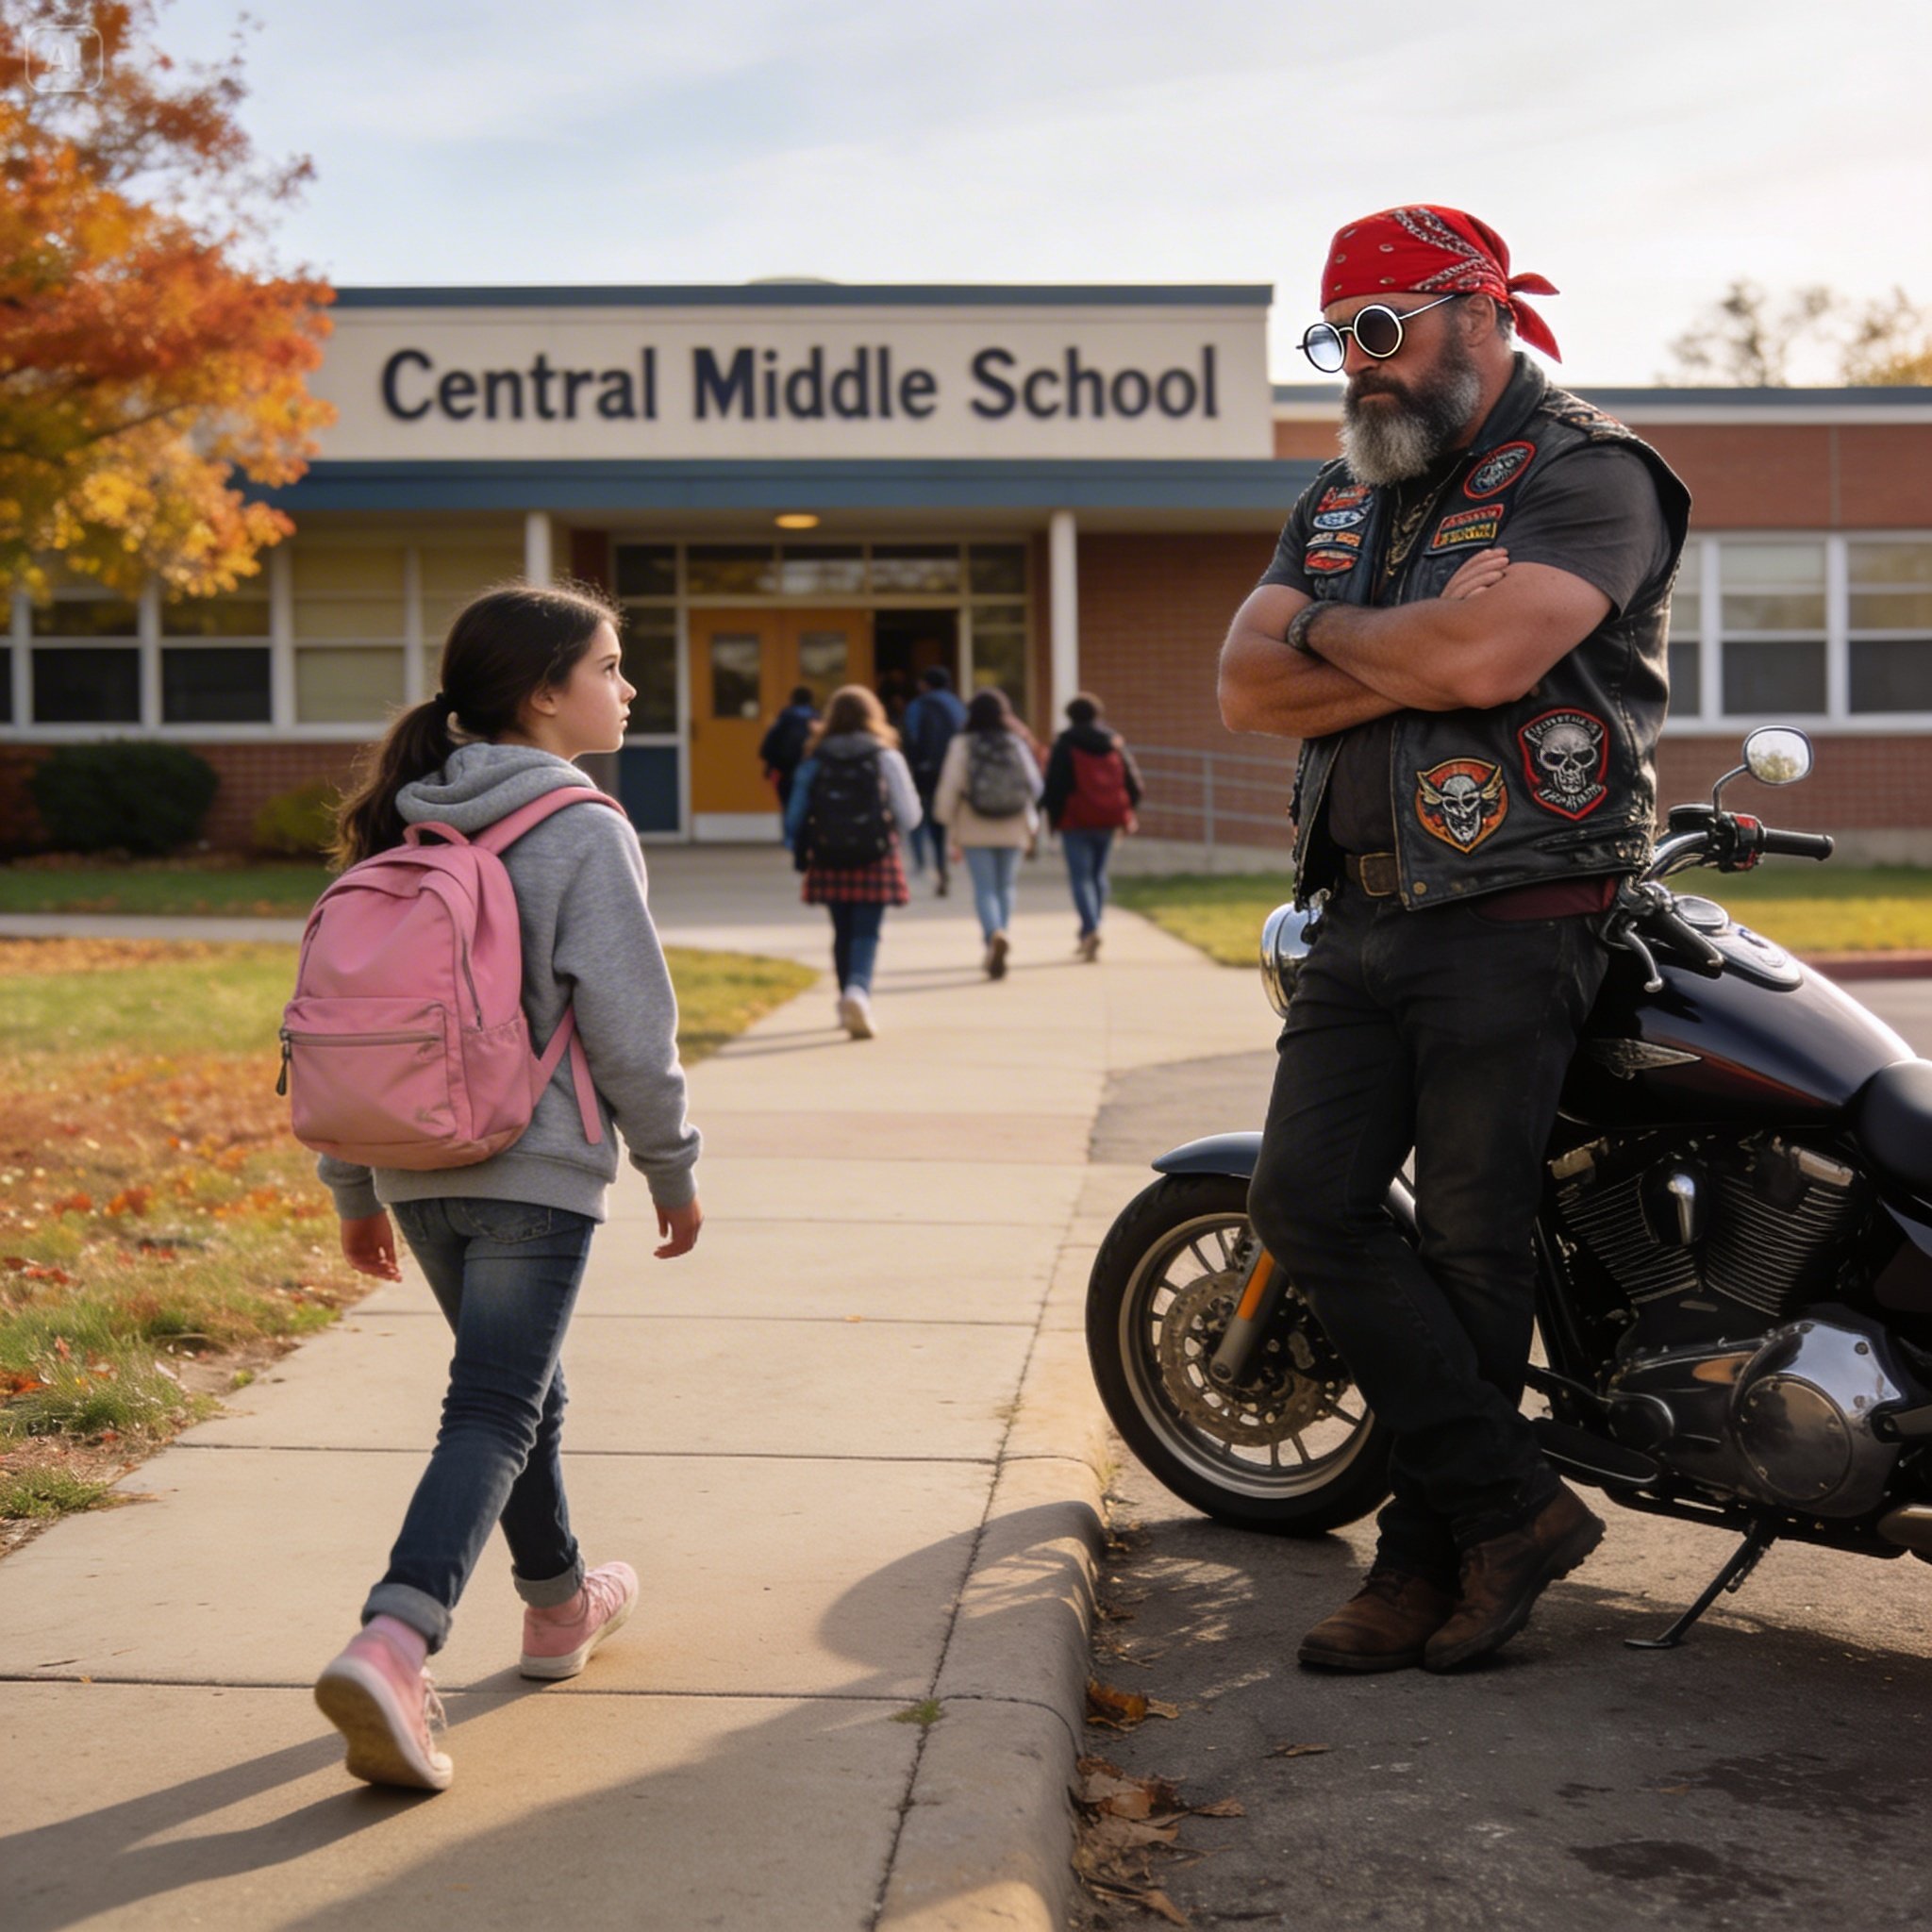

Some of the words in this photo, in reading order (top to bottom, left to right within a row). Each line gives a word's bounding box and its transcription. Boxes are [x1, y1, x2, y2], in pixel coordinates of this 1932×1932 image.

[379, 346, 658, 423] Central
[691, 345, 938, 421] Middle
[970, 344, 1218, 420] School
